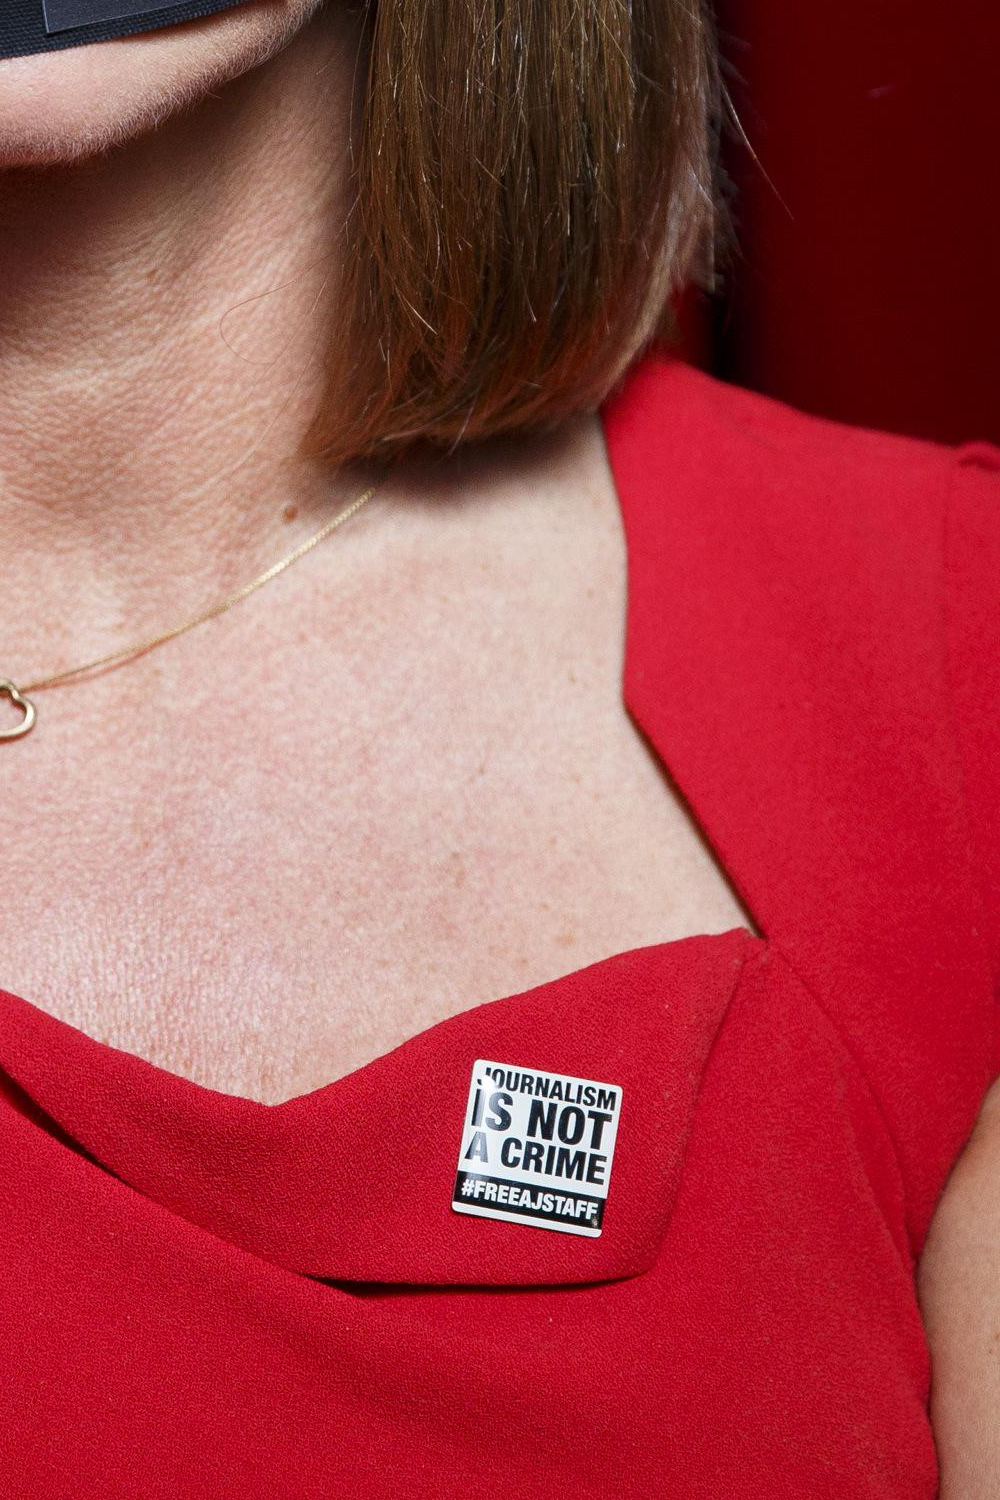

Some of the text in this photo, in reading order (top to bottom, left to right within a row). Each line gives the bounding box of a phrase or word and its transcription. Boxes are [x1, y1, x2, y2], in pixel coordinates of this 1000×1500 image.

[471, 1089, 612, 1150] IS NOT
[464, 1131, 607, 1185] A CRIME
[461, 1178, 598, 1220] #FREEAJSTAFF
